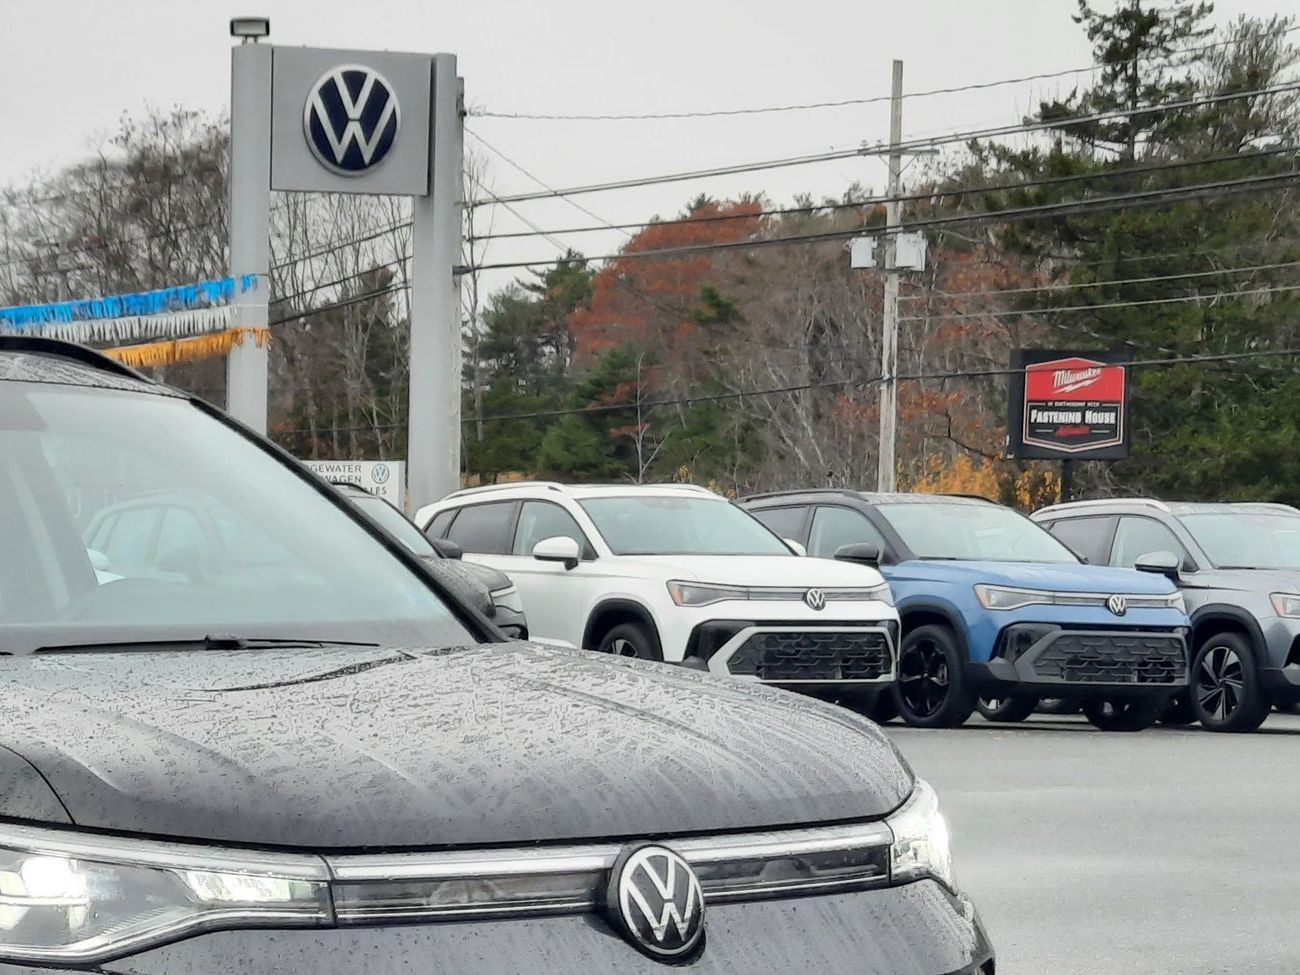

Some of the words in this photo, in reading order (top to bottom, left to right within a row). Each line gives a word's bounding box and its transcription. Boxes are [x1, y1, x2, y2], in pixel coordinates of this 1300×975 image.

[303, 64, 401, 178] VW
[1085, 410, 1116, 425] HOUSE
[325, 475, 362, 483] WAGEN
[619, 846, 704, 955] VW
